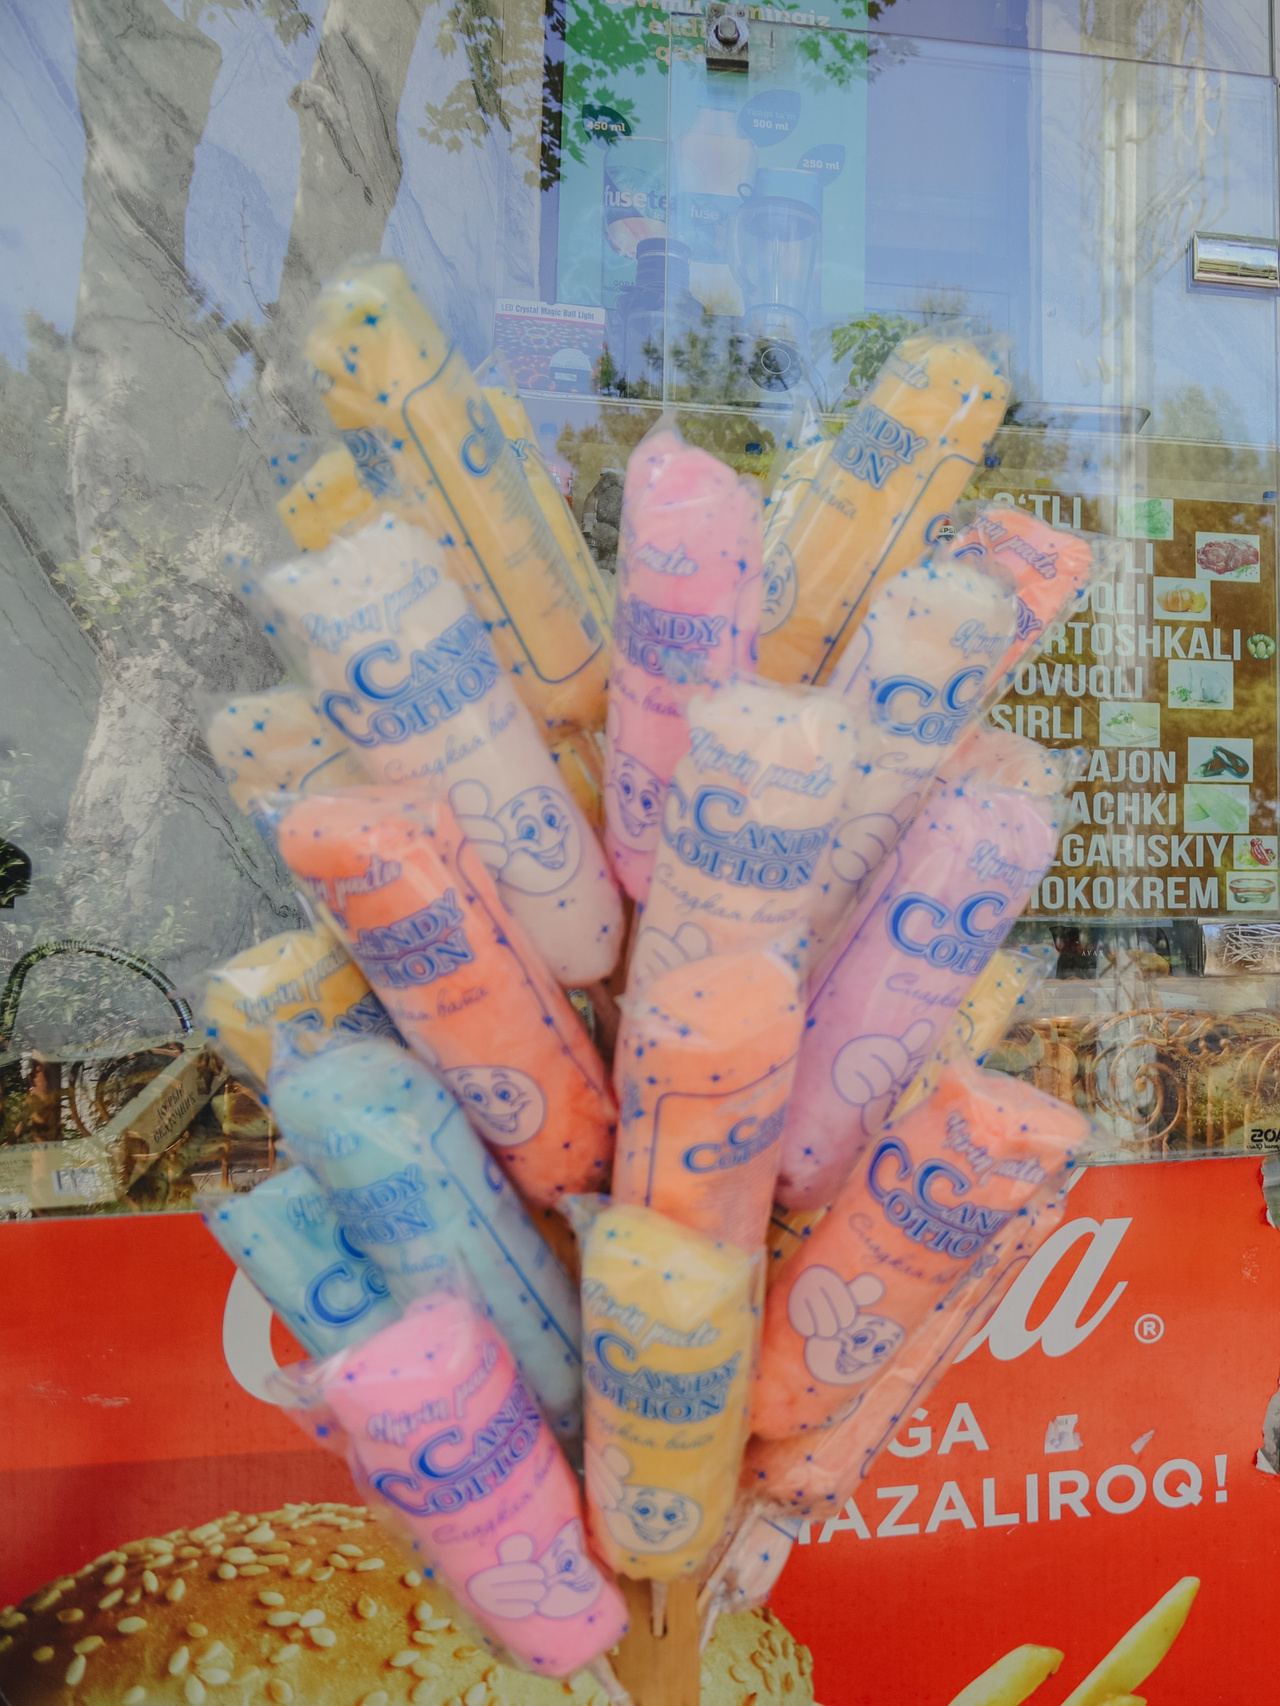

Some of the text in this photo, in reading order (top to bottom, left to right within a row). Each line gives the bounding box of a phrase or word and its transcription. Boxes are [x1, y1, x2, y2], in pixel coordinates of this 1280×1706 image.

[587, 120, 626, 132] 450 ml
[753, 119, 789, 131] 500 ml
[803, 158, 840, 170] 250 ml
[502, 303, 595, 321] LED Crystal Magic Ball Light
[866, 1136, 990, 1259] COTTO
